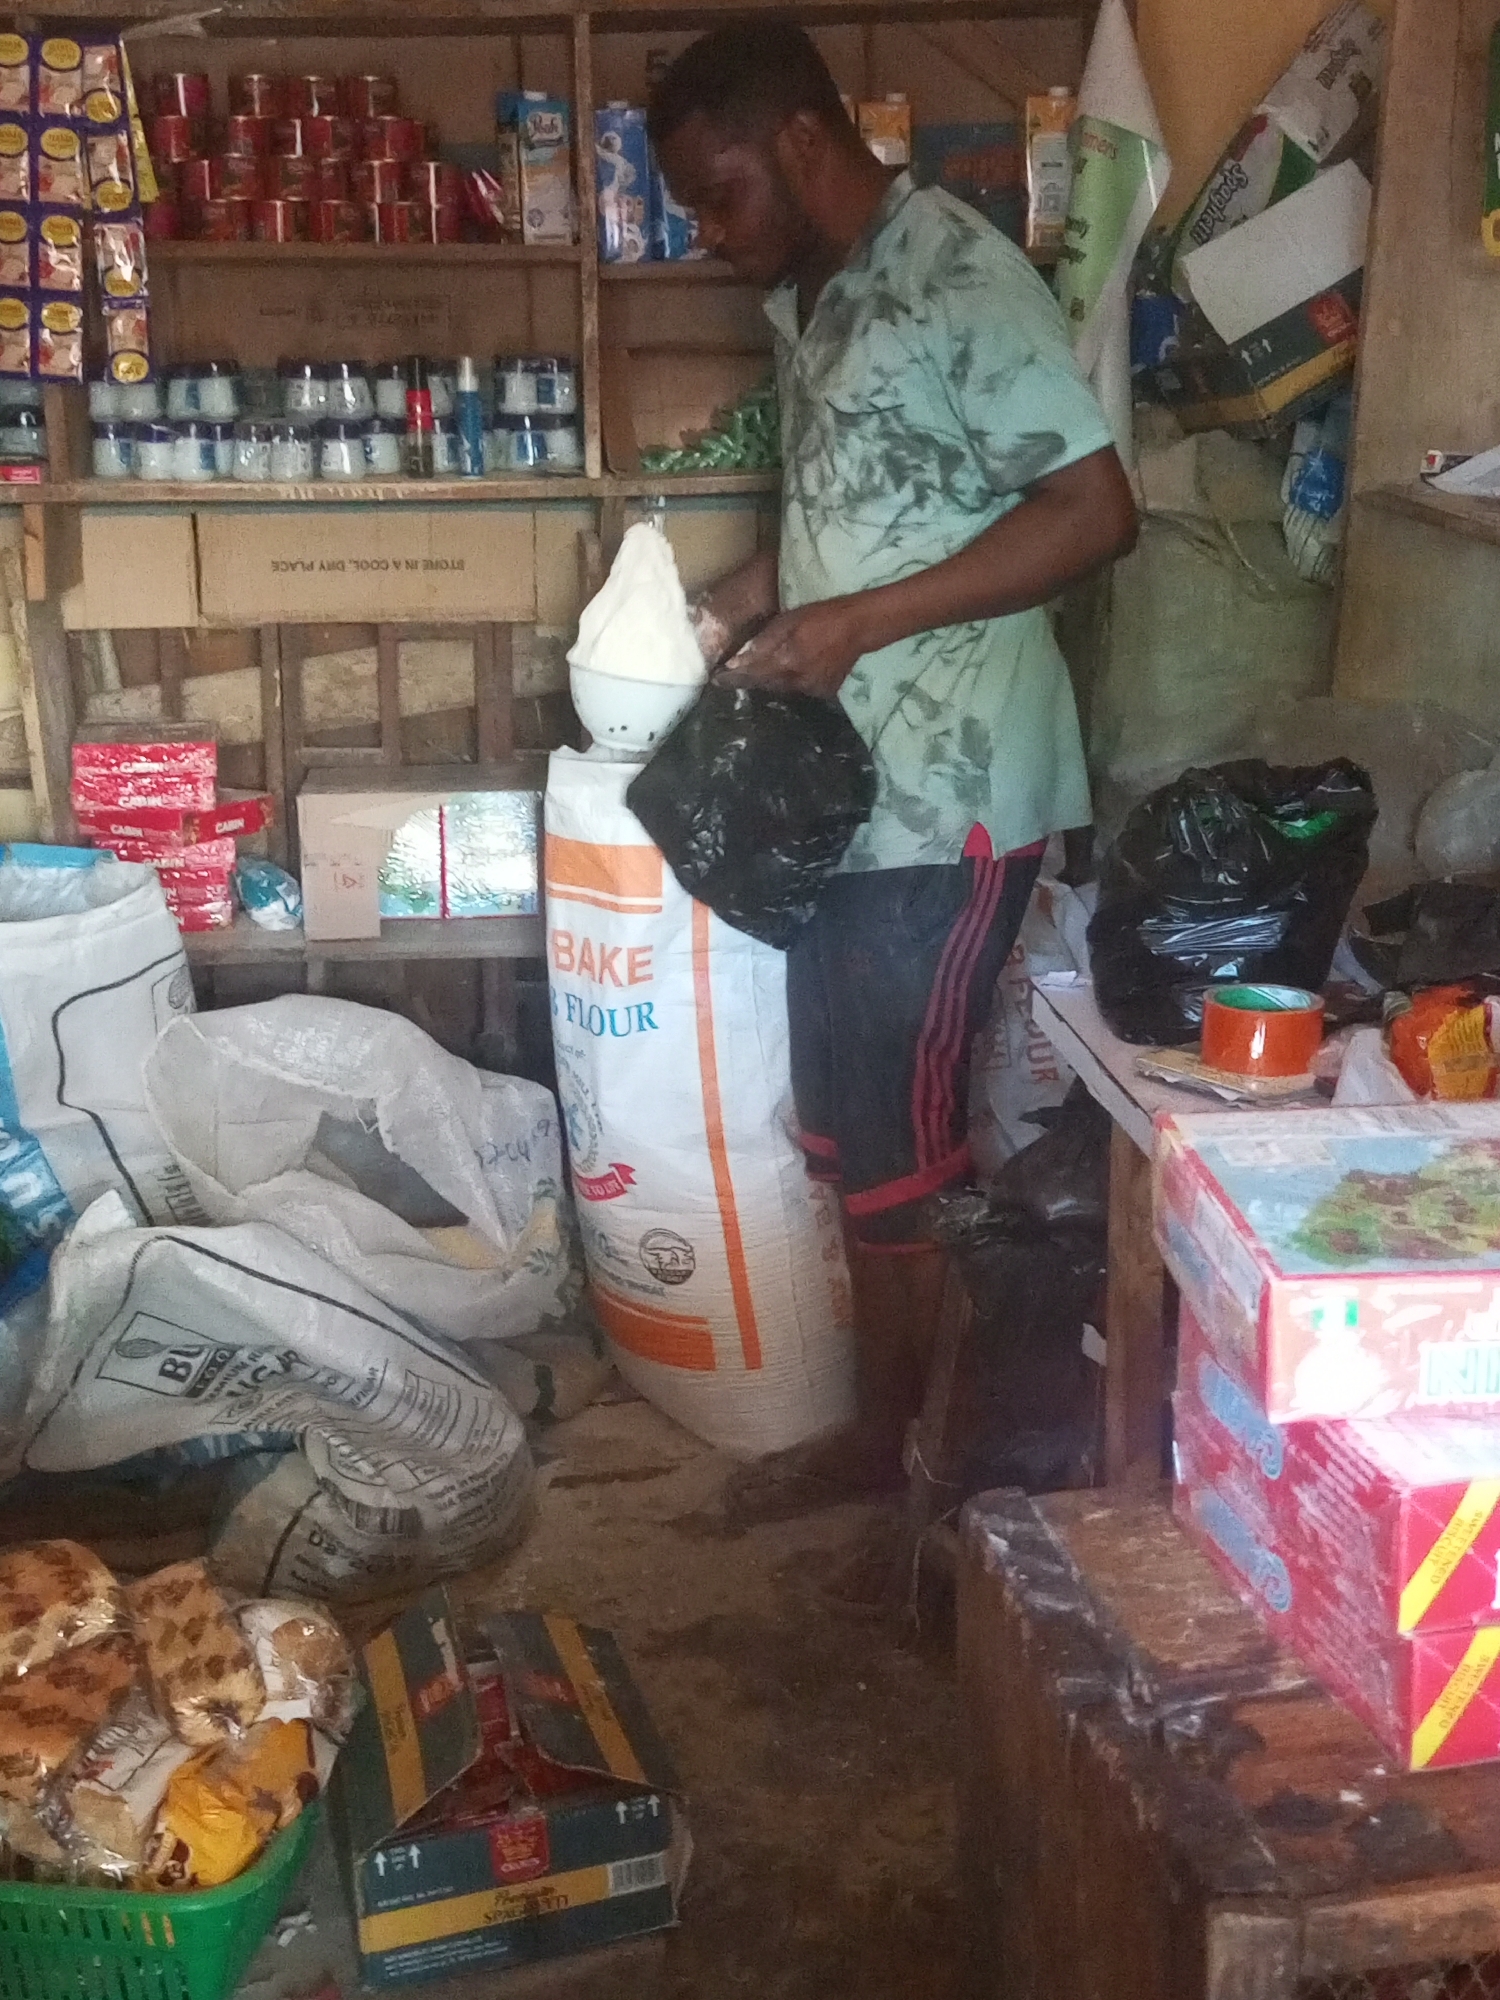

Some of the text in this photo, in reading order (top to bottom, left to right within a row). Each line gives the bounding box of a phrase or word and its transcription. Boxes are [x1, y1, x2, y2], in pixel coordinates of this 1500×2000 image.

[271, 559, 314, 572] PLACE
[318, 559, 346, 572] DRY
[405, 558, 419, 571] IN
[423, 558, 465, 571] STORE
[215, 818, 245, 834] CABIN
[552, 928, 654, 988] BAKE
[563, 991, 659, 1037] FLOUR
